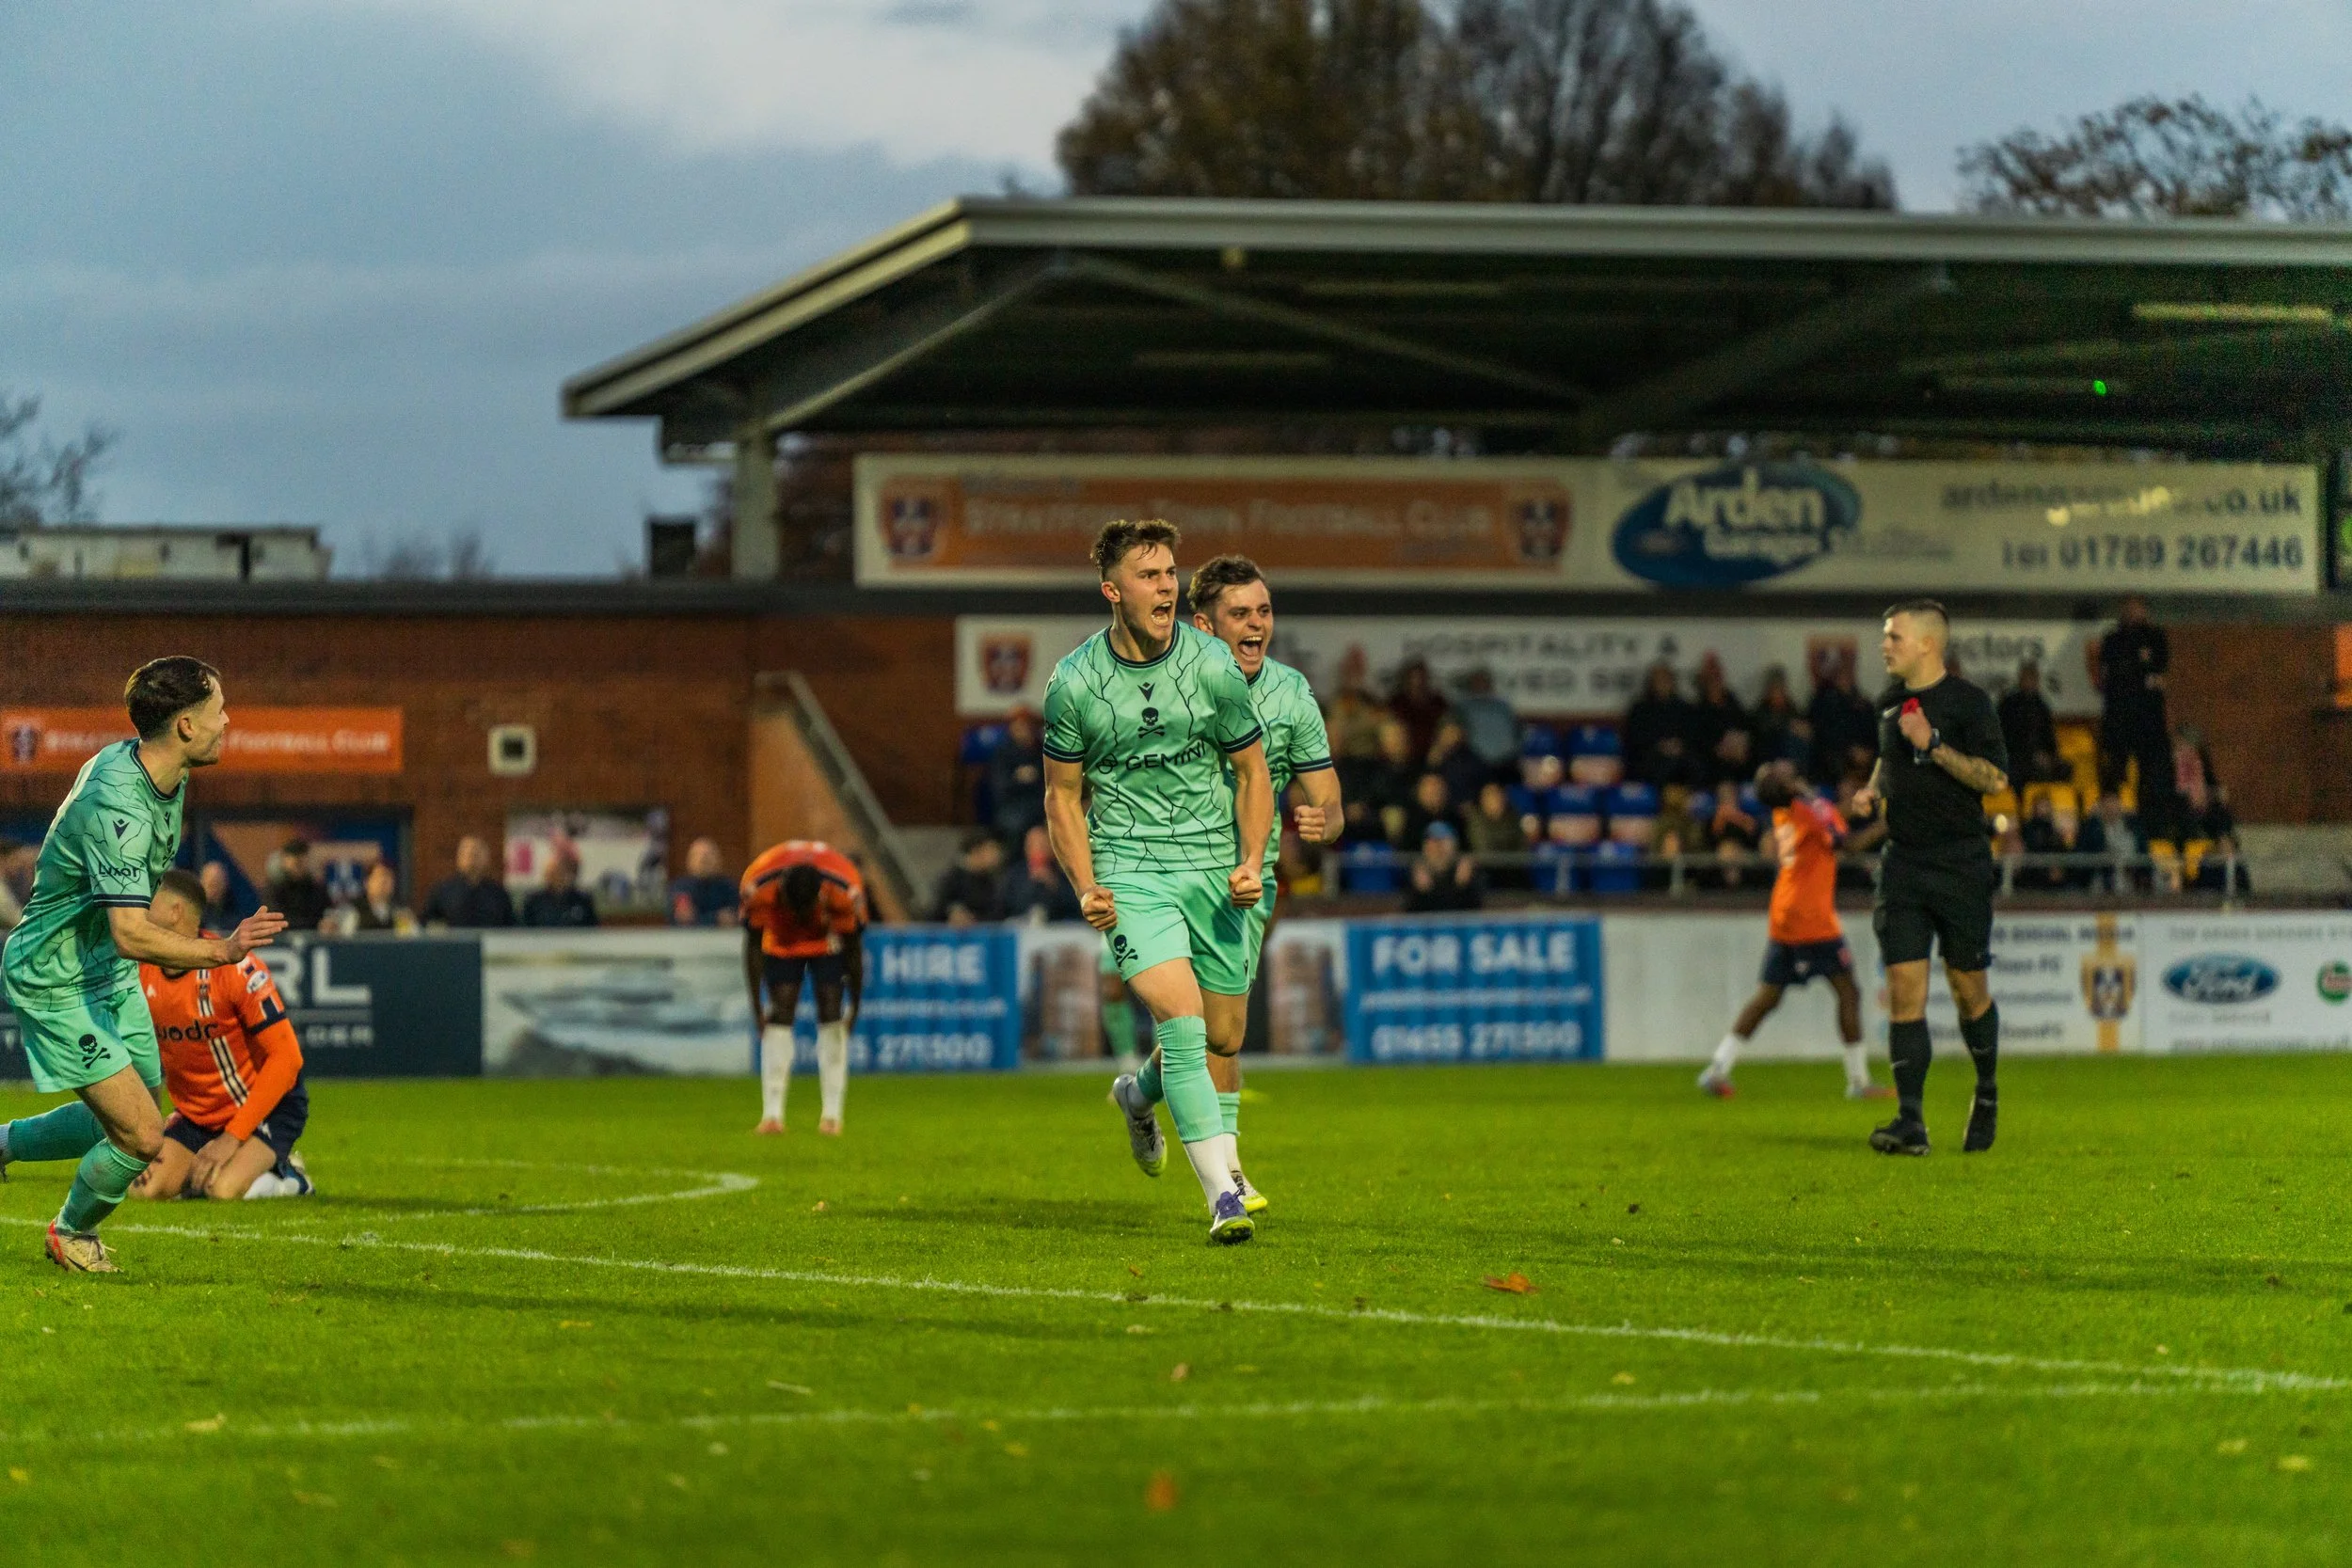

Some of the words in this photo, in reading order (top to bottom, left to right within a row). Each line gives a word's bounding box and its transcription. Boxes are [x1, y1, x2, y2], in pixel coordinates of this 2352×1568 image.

[1662, 468, 1826, 529] Arden
[2059, 534, 2164, 571] 01789
[2176, 533, 2304, 571] 267446
[1125, 738, 1207, 771] GEMINI
[881, 943, 988, 986] HIRE
[1372, 934, 1461, 977] FOR
[1470, 929, 1578, 974] SALE
